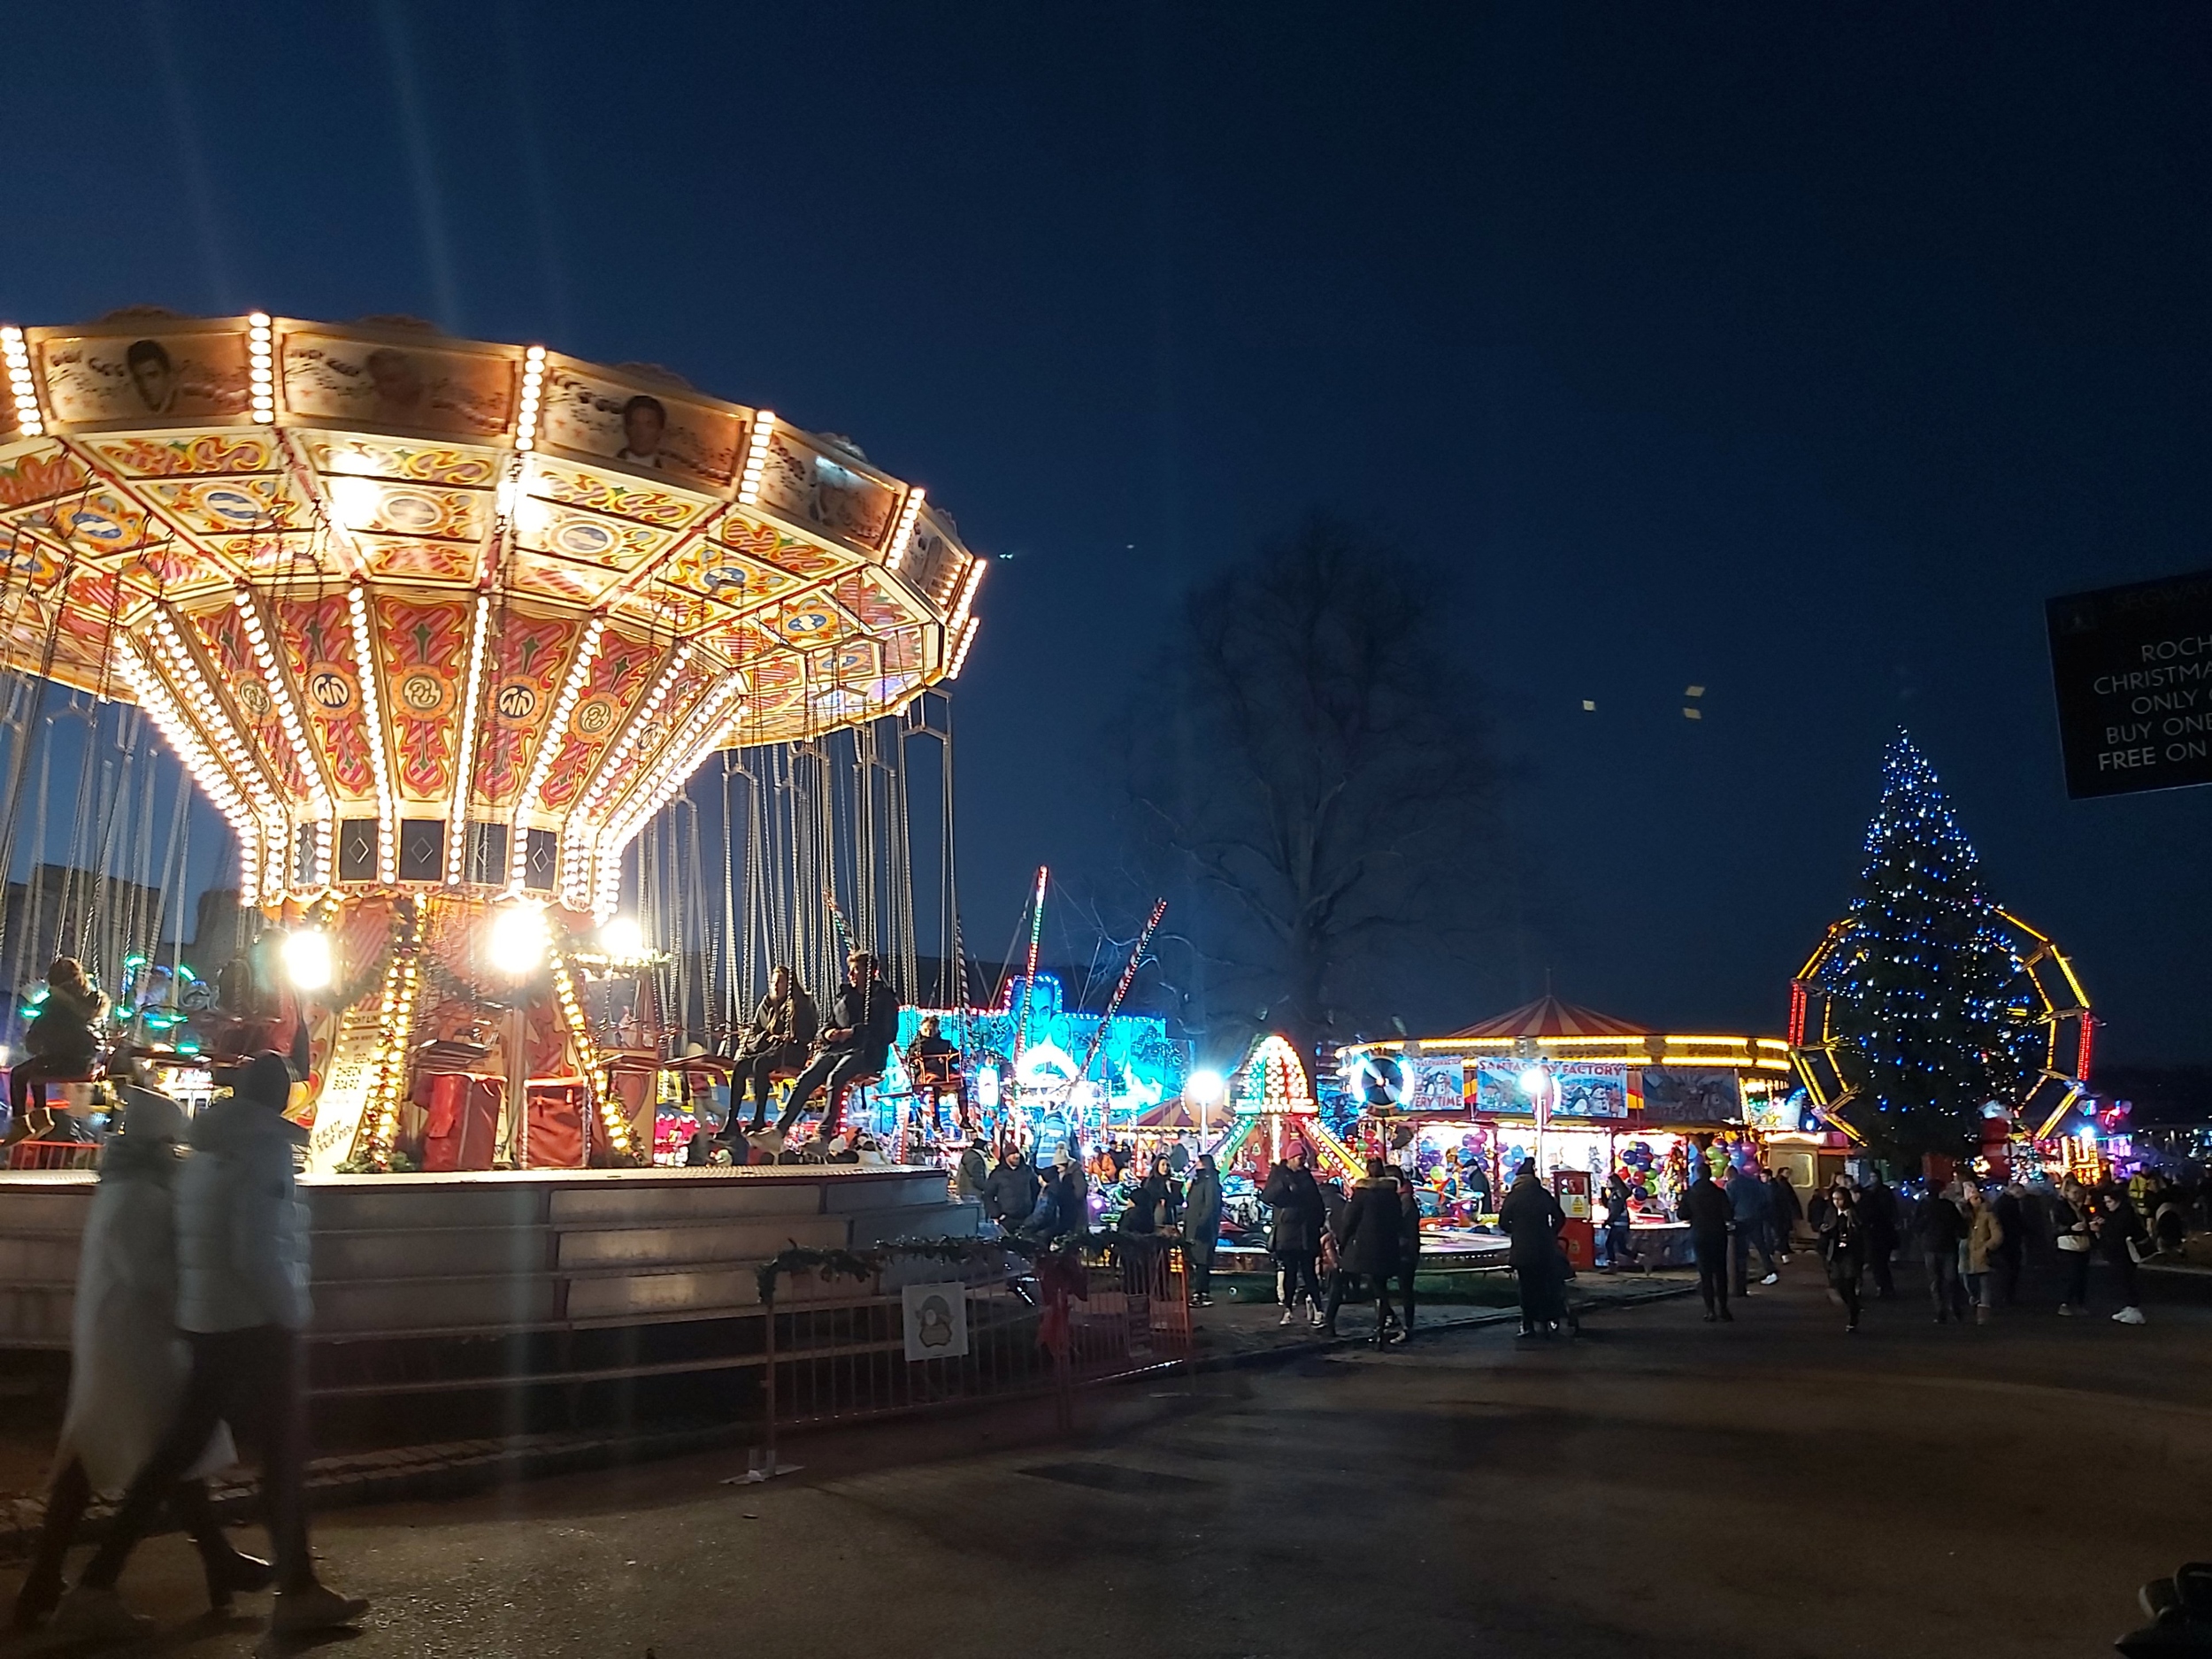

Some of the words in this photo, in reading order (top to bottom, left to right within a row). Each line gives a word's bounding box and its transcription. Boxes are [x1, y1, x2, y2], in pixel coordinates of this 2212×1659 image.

[2141, 635, 2212, 662] ROCH
[2131, 688, 2199, 714] ONLY
[2106, 721, 2153, 744] BUY
[2162, 712, 2212, 736] ONE
[2098, 746, 2156, 771] FREE
[1563, 1064, 1622, 1076] FACTORY
[1437, 1095, 1462, 1107] TIME
